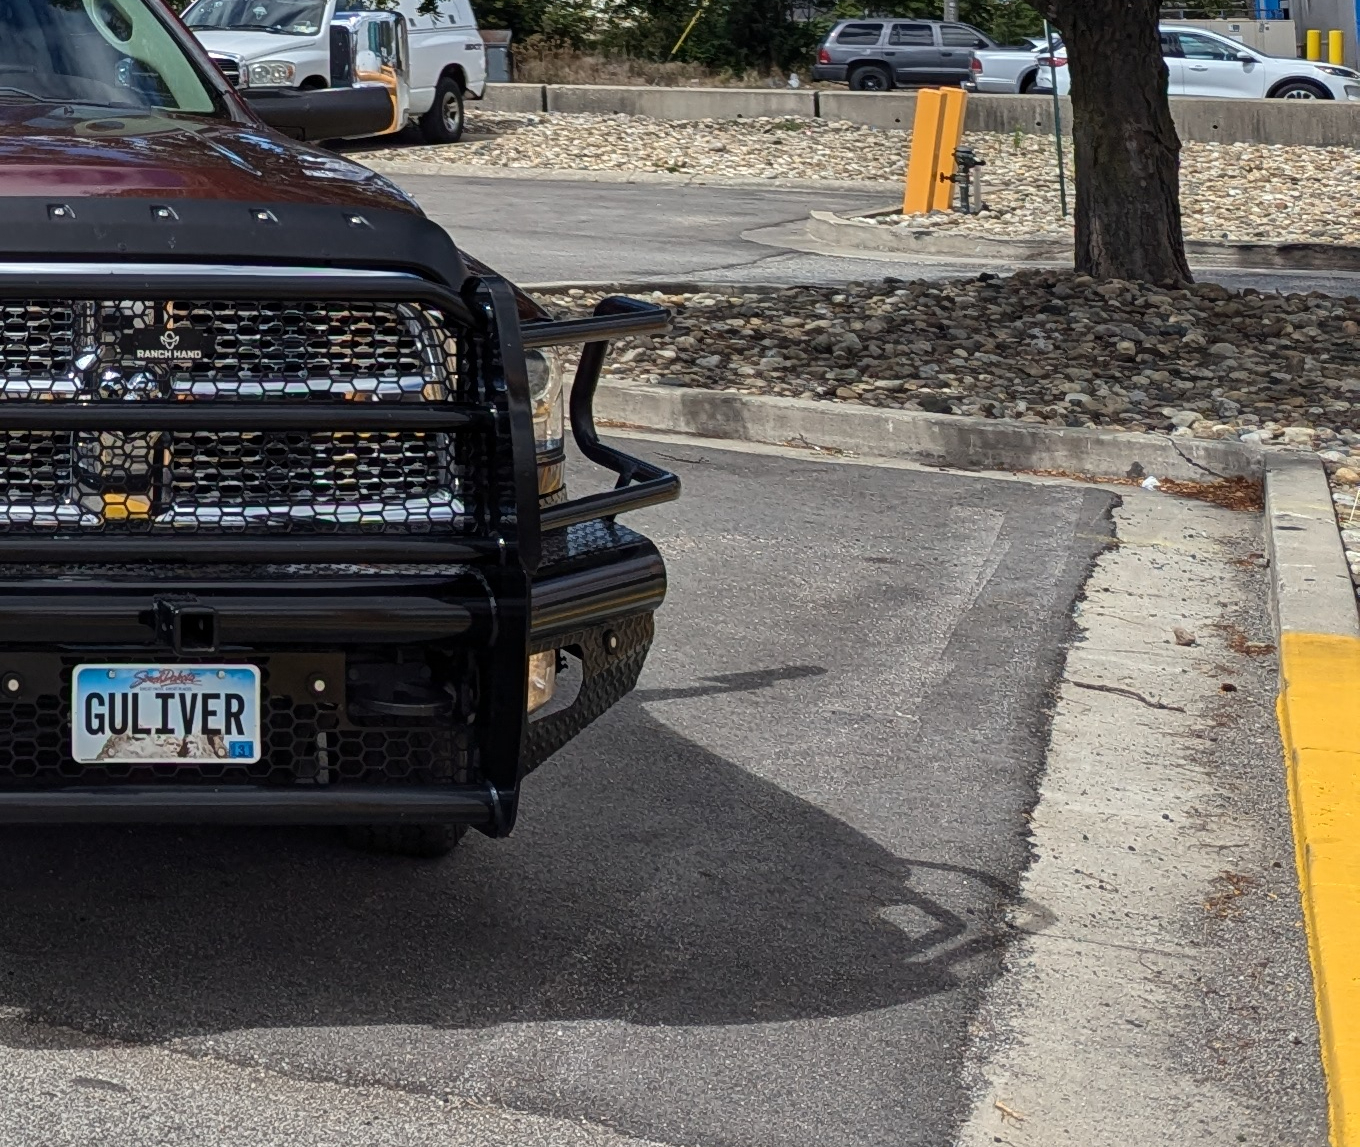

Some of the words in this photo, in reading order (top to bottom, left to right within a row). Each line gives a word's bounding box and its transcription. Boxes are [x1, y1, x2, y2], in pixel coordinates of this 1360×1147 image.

[136, 349, 172, 359] RANCH
[173, 349, 202, 359] HAND
[84, 692, 245, 736] GULIVER
